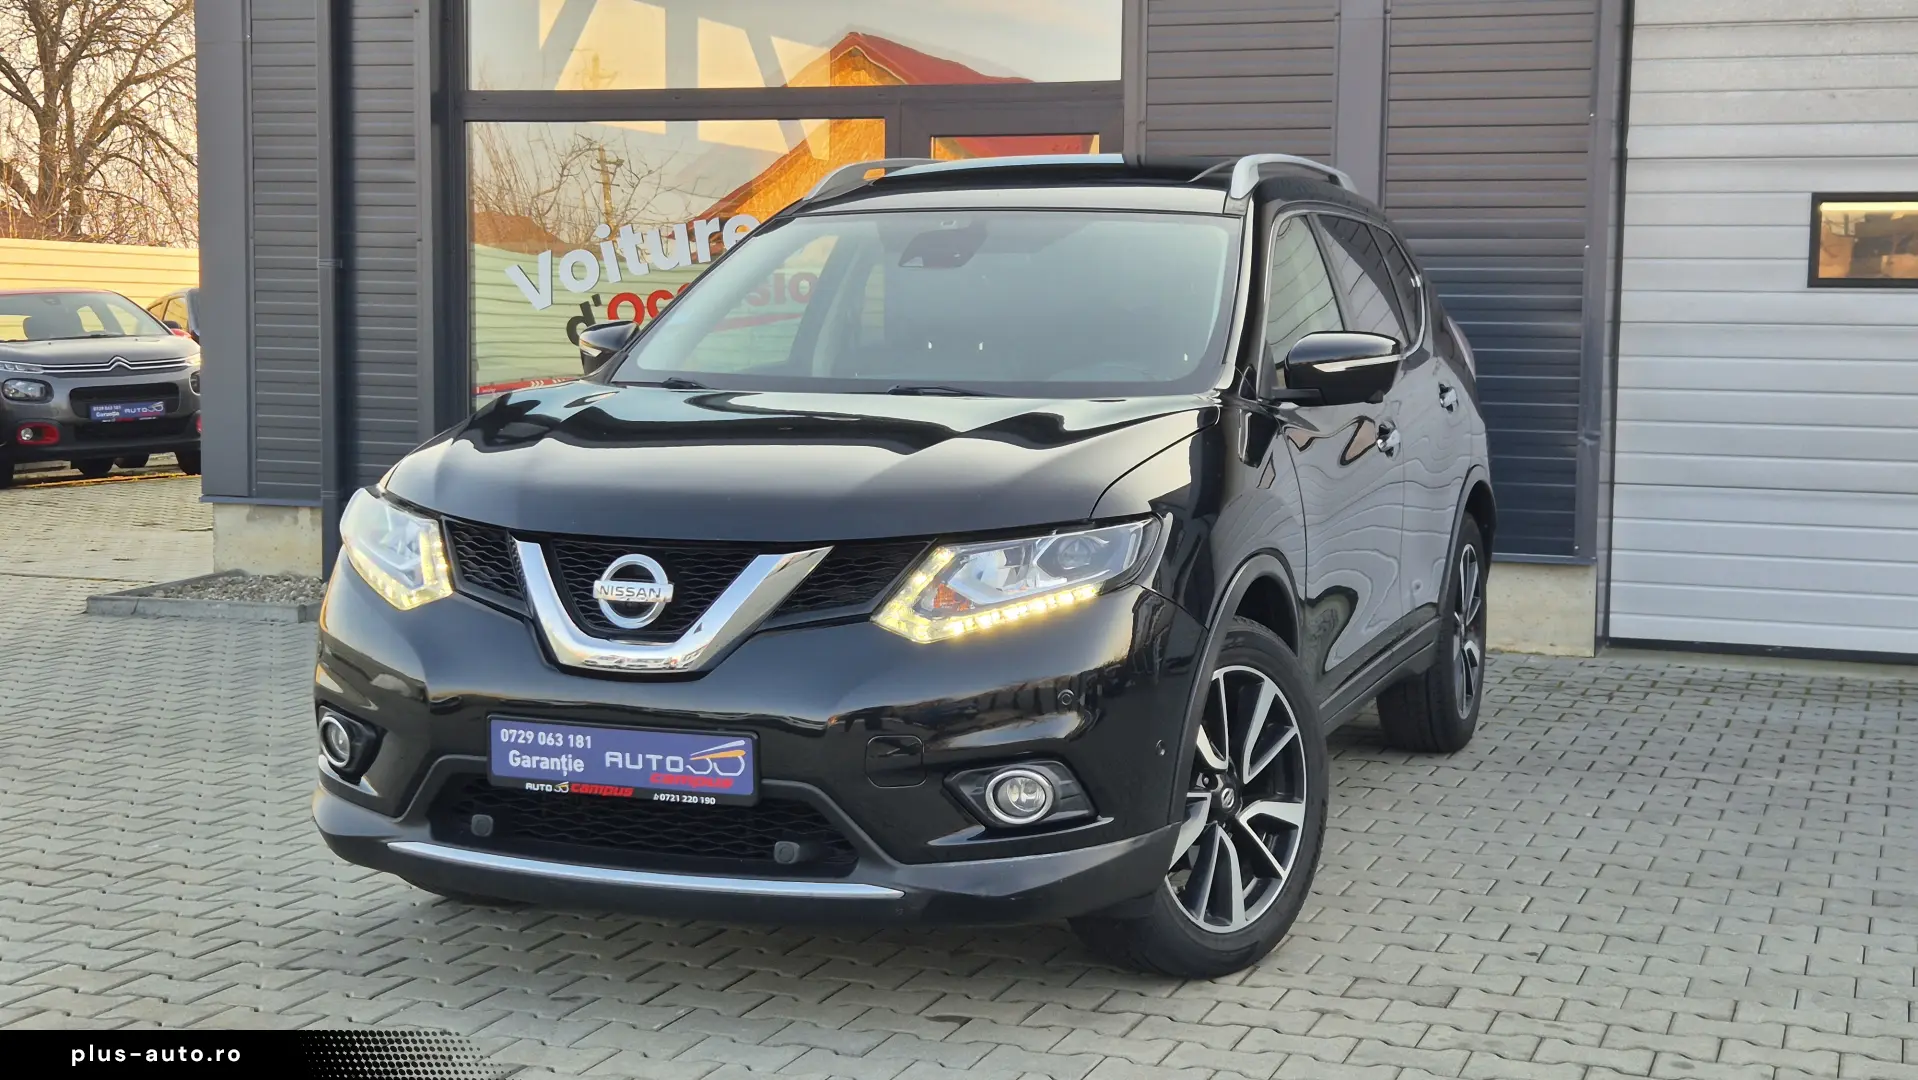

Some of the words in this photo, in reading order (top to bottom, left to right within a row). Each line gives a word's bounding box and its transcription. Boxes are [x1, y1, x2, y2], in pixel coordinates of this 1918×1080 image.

[600, 585, 662, 598] NISSAN
[500, 728, 534, 745] 0729
[538, 731, 564, 747] 063
[568, 733, 592, 749] 181
[508, 749, 585, 776] Garanție
[604, 751, 685, 773] AUTO
[525, 782, 553, 792] AUTO
[571, 783, 634, 797] campus
[659, 793, 680, 802] 0721
[682, 795, 698, 804] 220
[700, 796, 716, 805] 190
